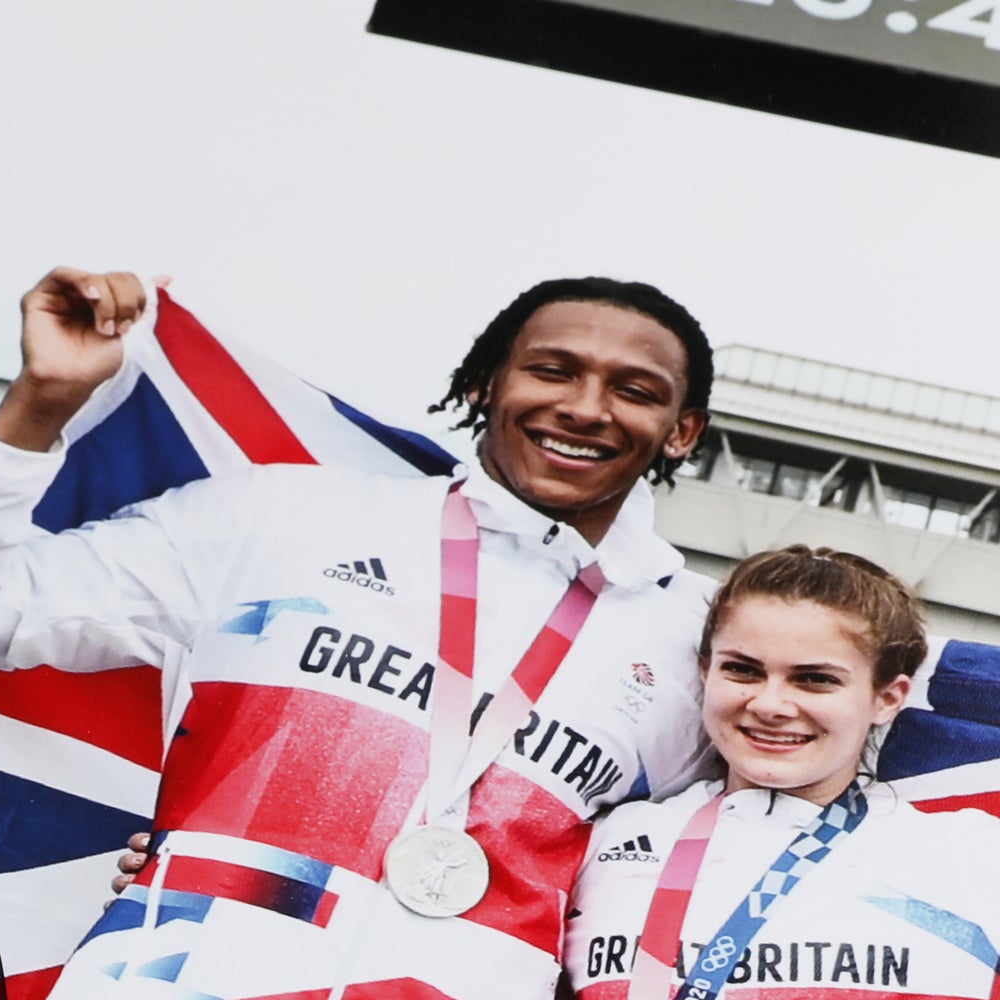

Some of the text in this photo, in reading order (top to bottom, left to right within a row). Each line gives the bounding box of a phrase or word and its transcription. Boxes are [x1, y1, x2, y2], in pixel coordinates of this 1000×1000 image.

[322, 567, 396, 597] adidas
[299, 625, 437, 712] GREA
[597, 852, 661, 863] adidas
[726, 942, 910, 987] BRITAIN
